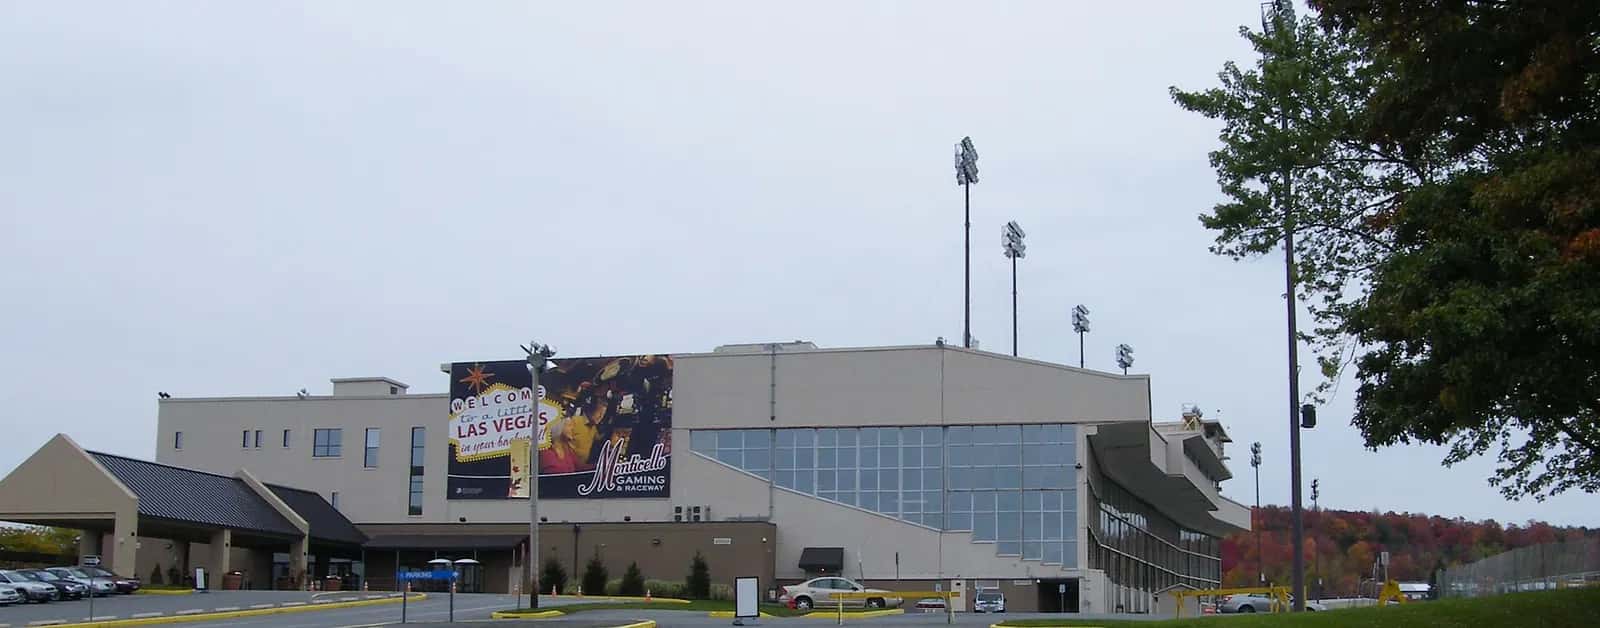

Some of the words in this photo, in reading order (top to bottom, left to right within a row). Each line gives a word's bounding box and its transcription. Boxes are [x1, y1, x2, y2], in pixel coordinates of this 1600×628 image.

[453, 387, 543, 411] WELCOME
[461, 414, 476, 423] to
[498, 404, 534, 417] littl
[457, 421, 488, 438] LAS
[461, 444, 470, 453] in
[577, 437, 667, 496] Monticello
[616, 475, 665, 485] GAMING
[625, 484, 665, 492] RACEWAY
